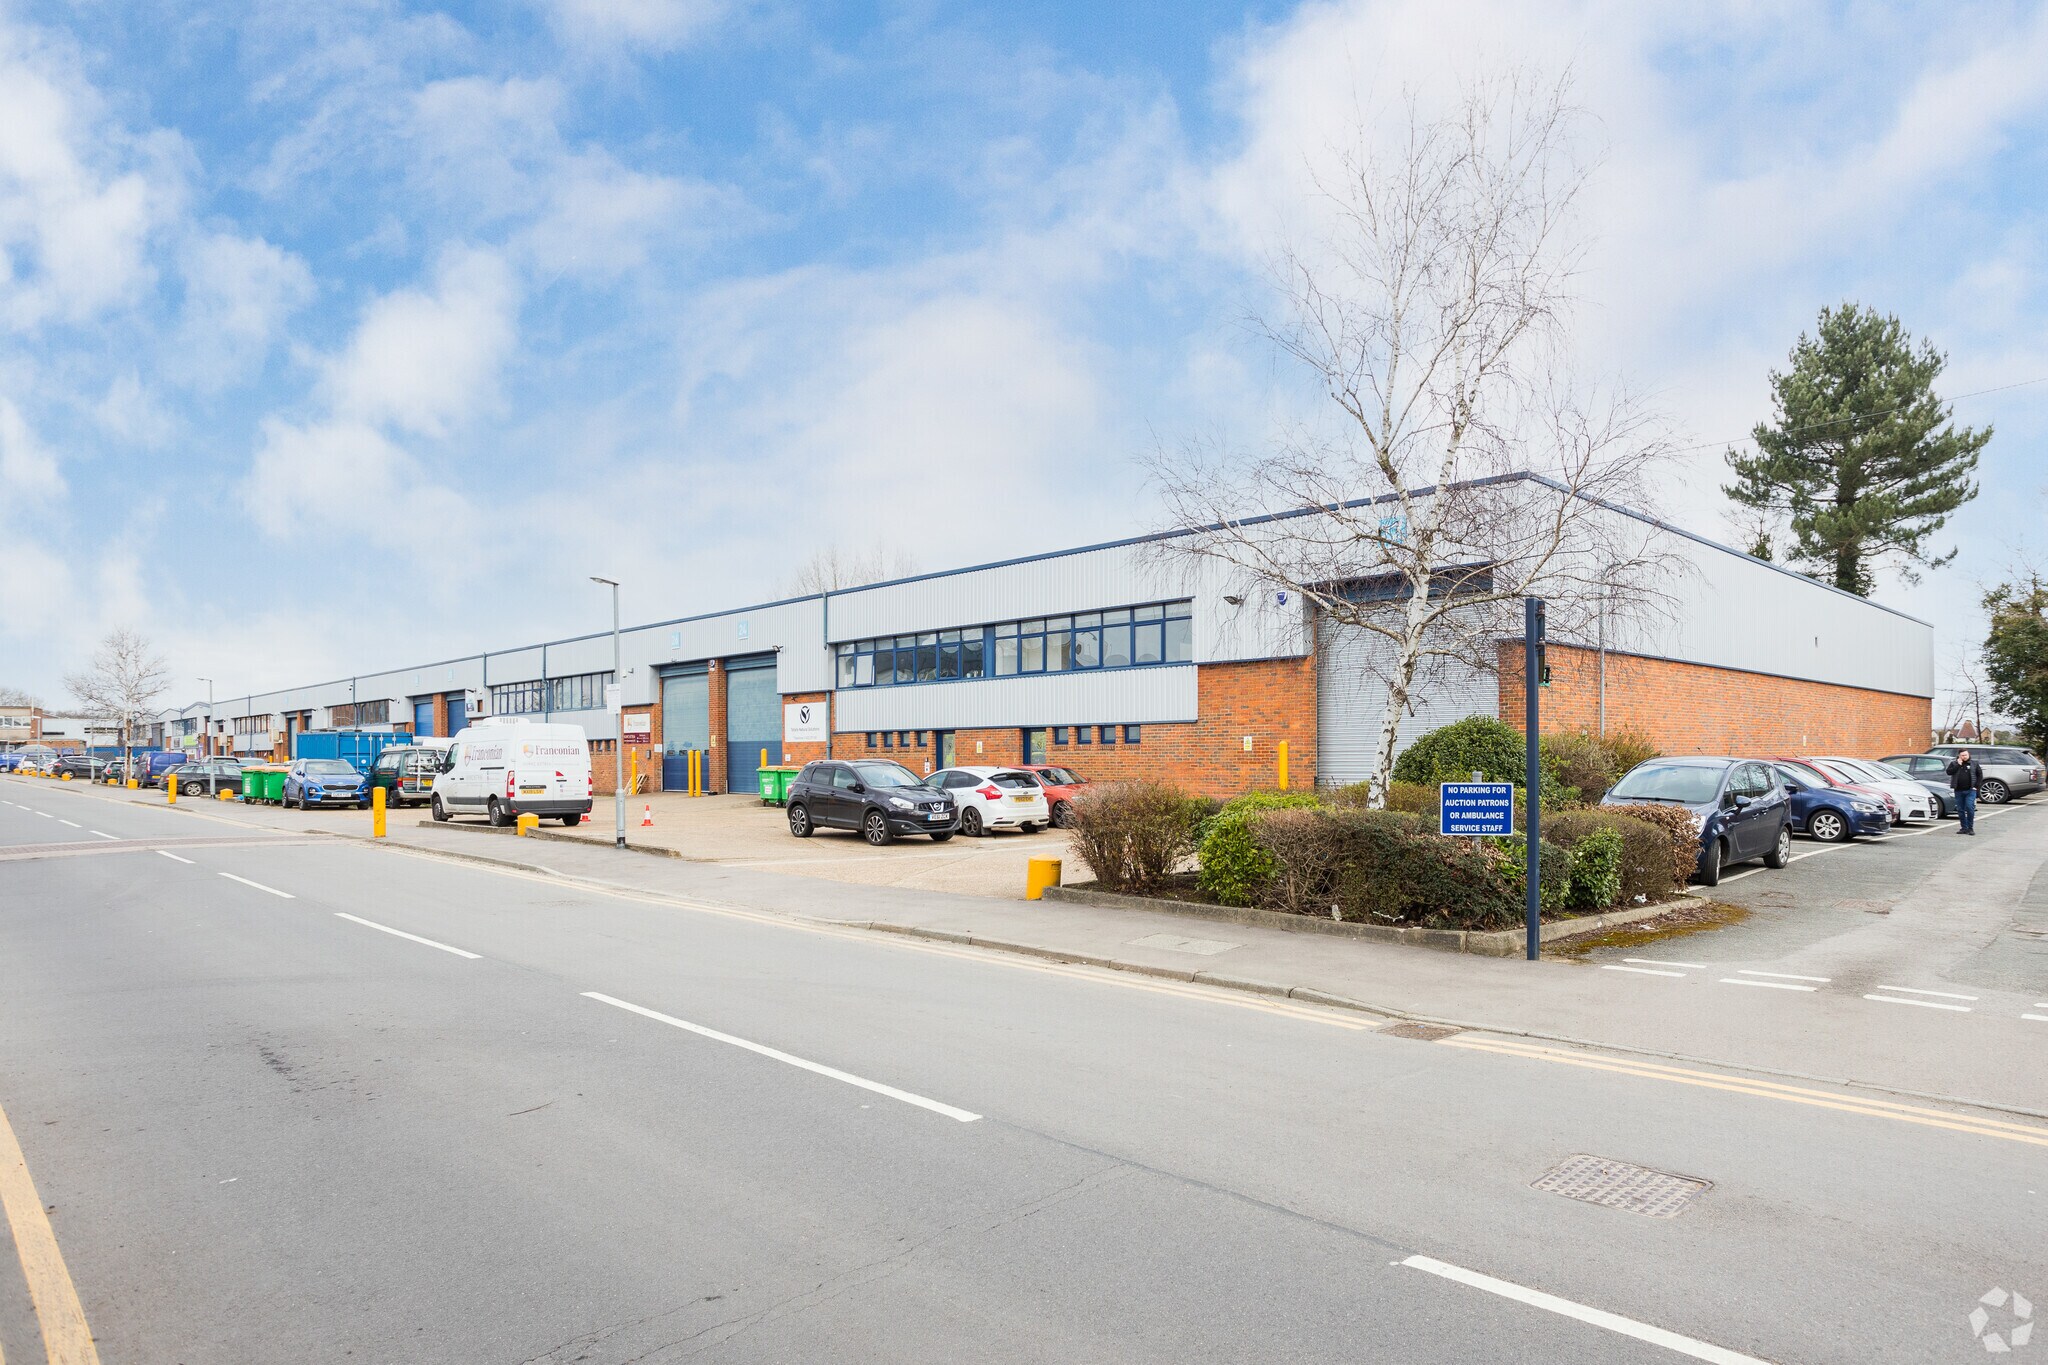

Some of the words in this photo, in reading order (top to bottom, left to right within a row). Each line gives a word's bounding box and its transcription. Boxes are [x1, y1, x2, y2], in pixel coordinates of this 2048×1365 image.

[471, 744, 503, 760] Franconian
[535, 745, 580, 756] Franconian
[1448, 786, 1458, 794] NO
[1460, 786, 1490, 794] PARKING
[1492, 786, 1506, 794] FOR
[1445, 799, 1476, 807] AUCTION
[1477, 799, 1509, 807] PATRONS
[1450, 824, 1480, 832] SERVICE
[1482, 824, 1503, 832] STAFF
